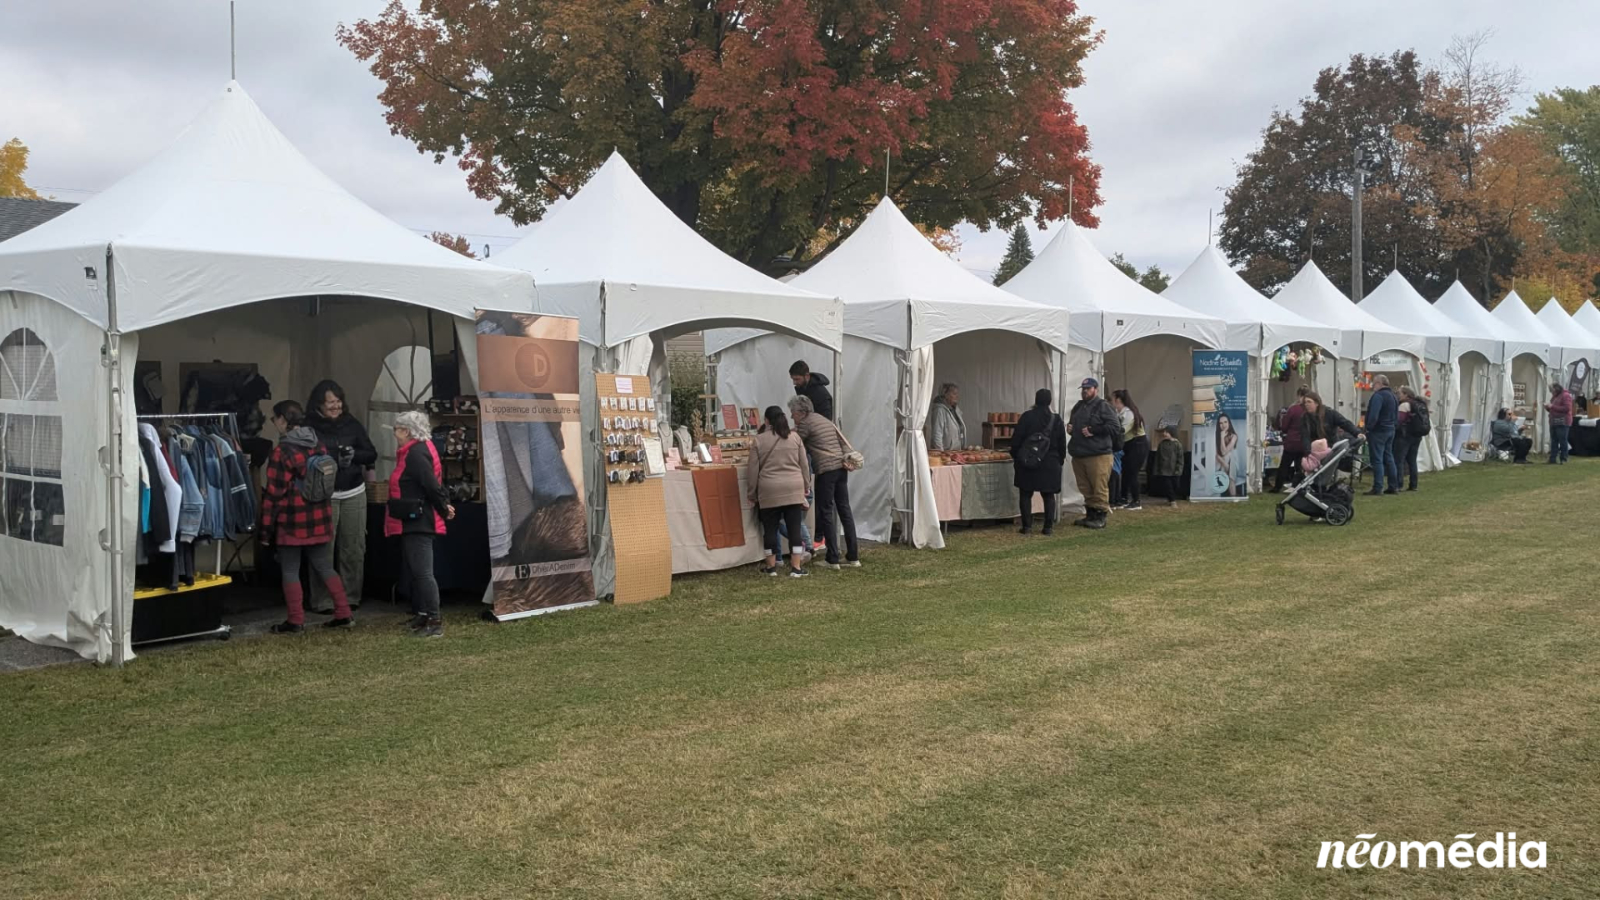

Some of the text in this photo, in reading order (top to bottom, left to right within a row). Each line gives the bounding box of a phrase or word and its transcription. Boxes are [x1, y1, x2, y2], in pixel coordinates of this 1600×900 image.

[484, 404, 530, 414] L'apparence
[531, 406, 551, 414] d'une
[552, 407, 571, 415] autre
